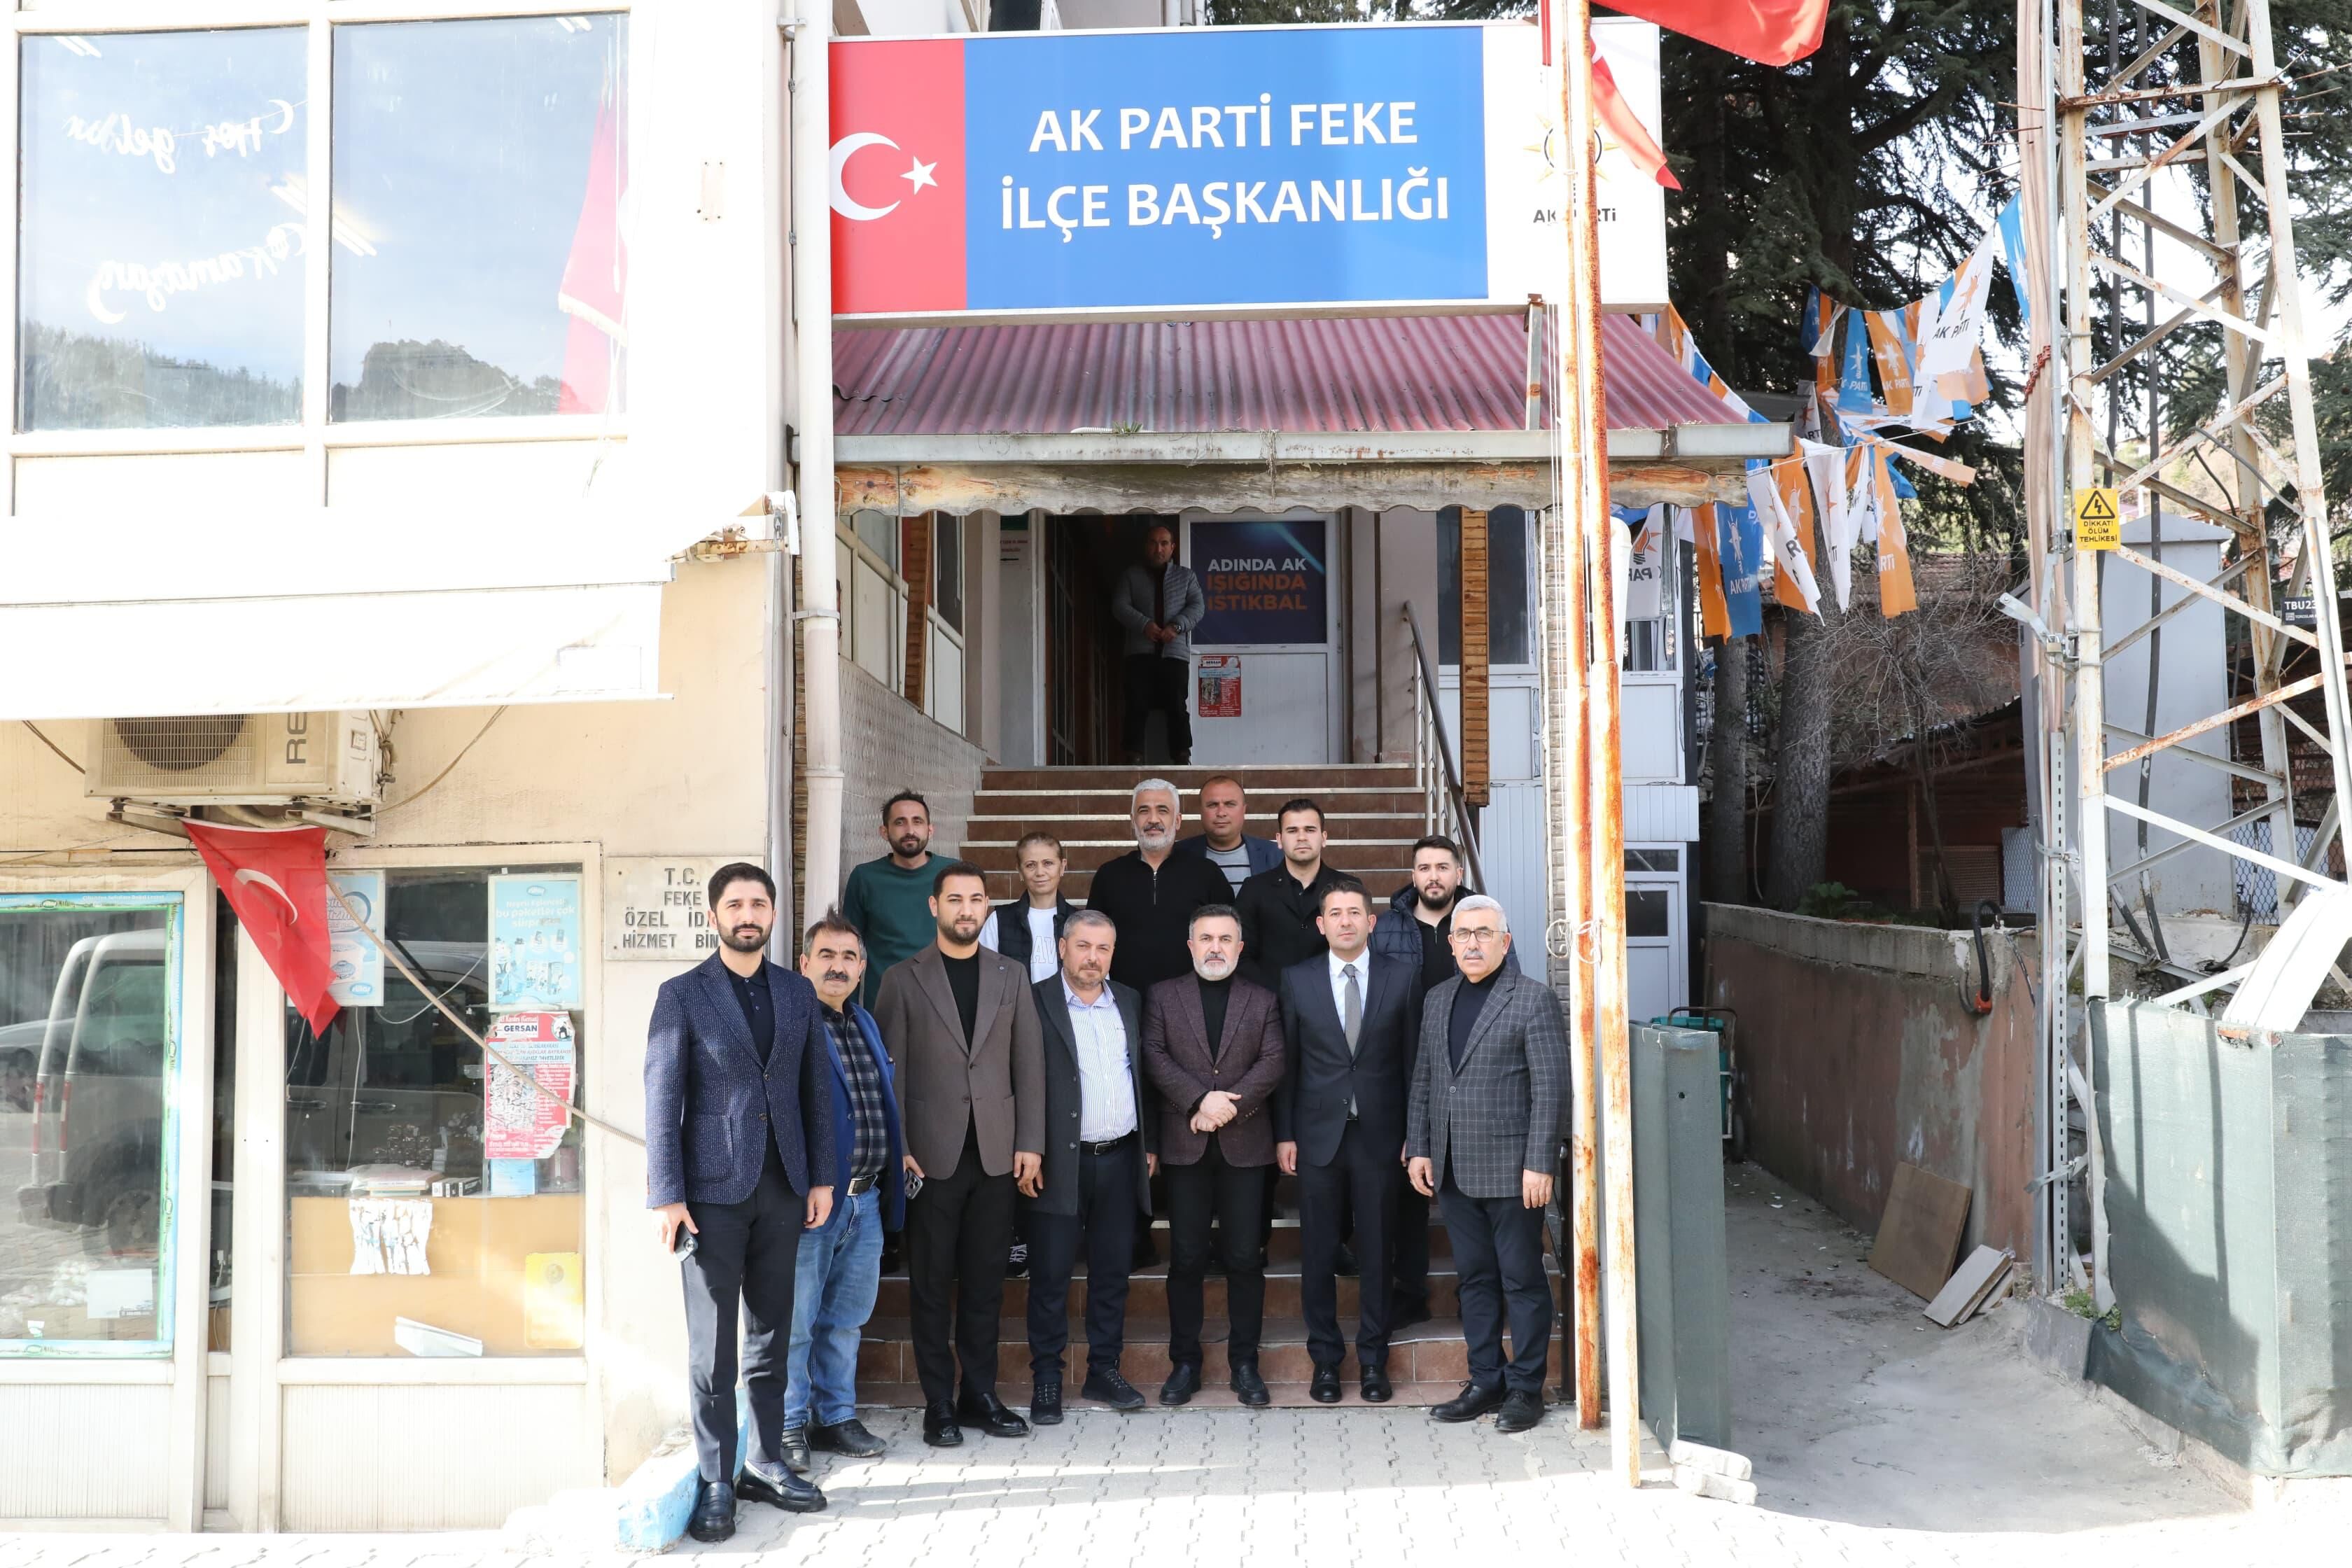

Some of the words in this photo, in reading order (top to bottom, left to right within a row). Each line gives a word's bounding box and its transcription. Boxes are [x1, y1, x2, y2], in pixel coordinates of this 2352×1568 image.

[1029, 108, 1104, 152] AK
[1120, 92, 1271, 150] PARTİ
[1291, 102, 1418, 146] FEKE
[1002, 175, 1110, 244] İLÇE
[1128, 167, 1448, 240] BAŞKANLIĞI
[1933, 326, 1951, 340] AK
[2080, 534, 2118, 542] TEHLİKESİ
[1208, 558, 1277, 572] ADINDA
[1281, 558, 1307, 571] AK
[1207, 572, 1308, 593] IŞIĞINDA
[664, 867, 700, 886] T.C.
[664, 891, 702, 906] FEKE
[625, 907, 669, 927] ÖZEL
[688, 906, 710, 927] İD
[623, 930, 678, 948] HİZMET
